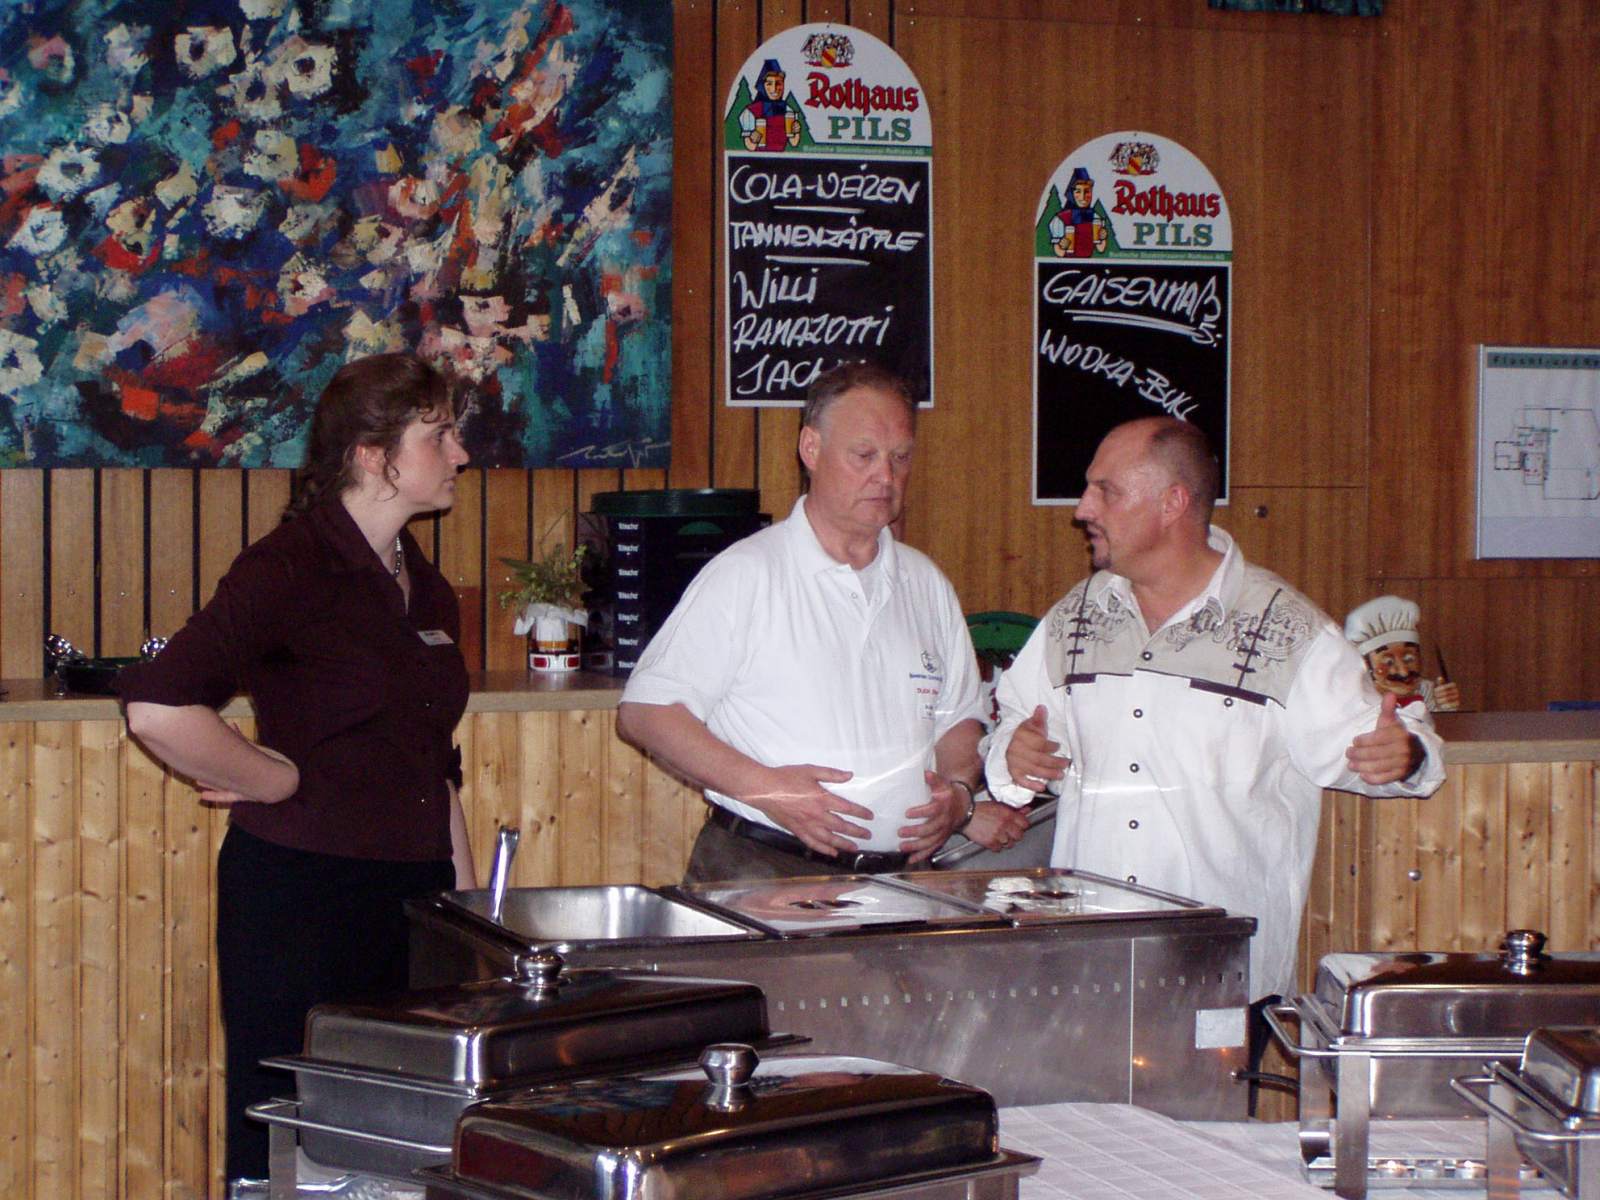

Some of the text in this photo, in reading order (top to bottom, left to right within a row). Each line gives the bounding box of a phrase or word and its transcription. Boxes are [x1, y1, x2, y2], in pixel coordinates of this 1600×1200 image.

[804, 71, 919, 117] Rothaus
[828, 116, 912, 141] PILS
[1111, 179, 1221, 223] Rothaus
[1133, 222, 1213, 247] PILS
